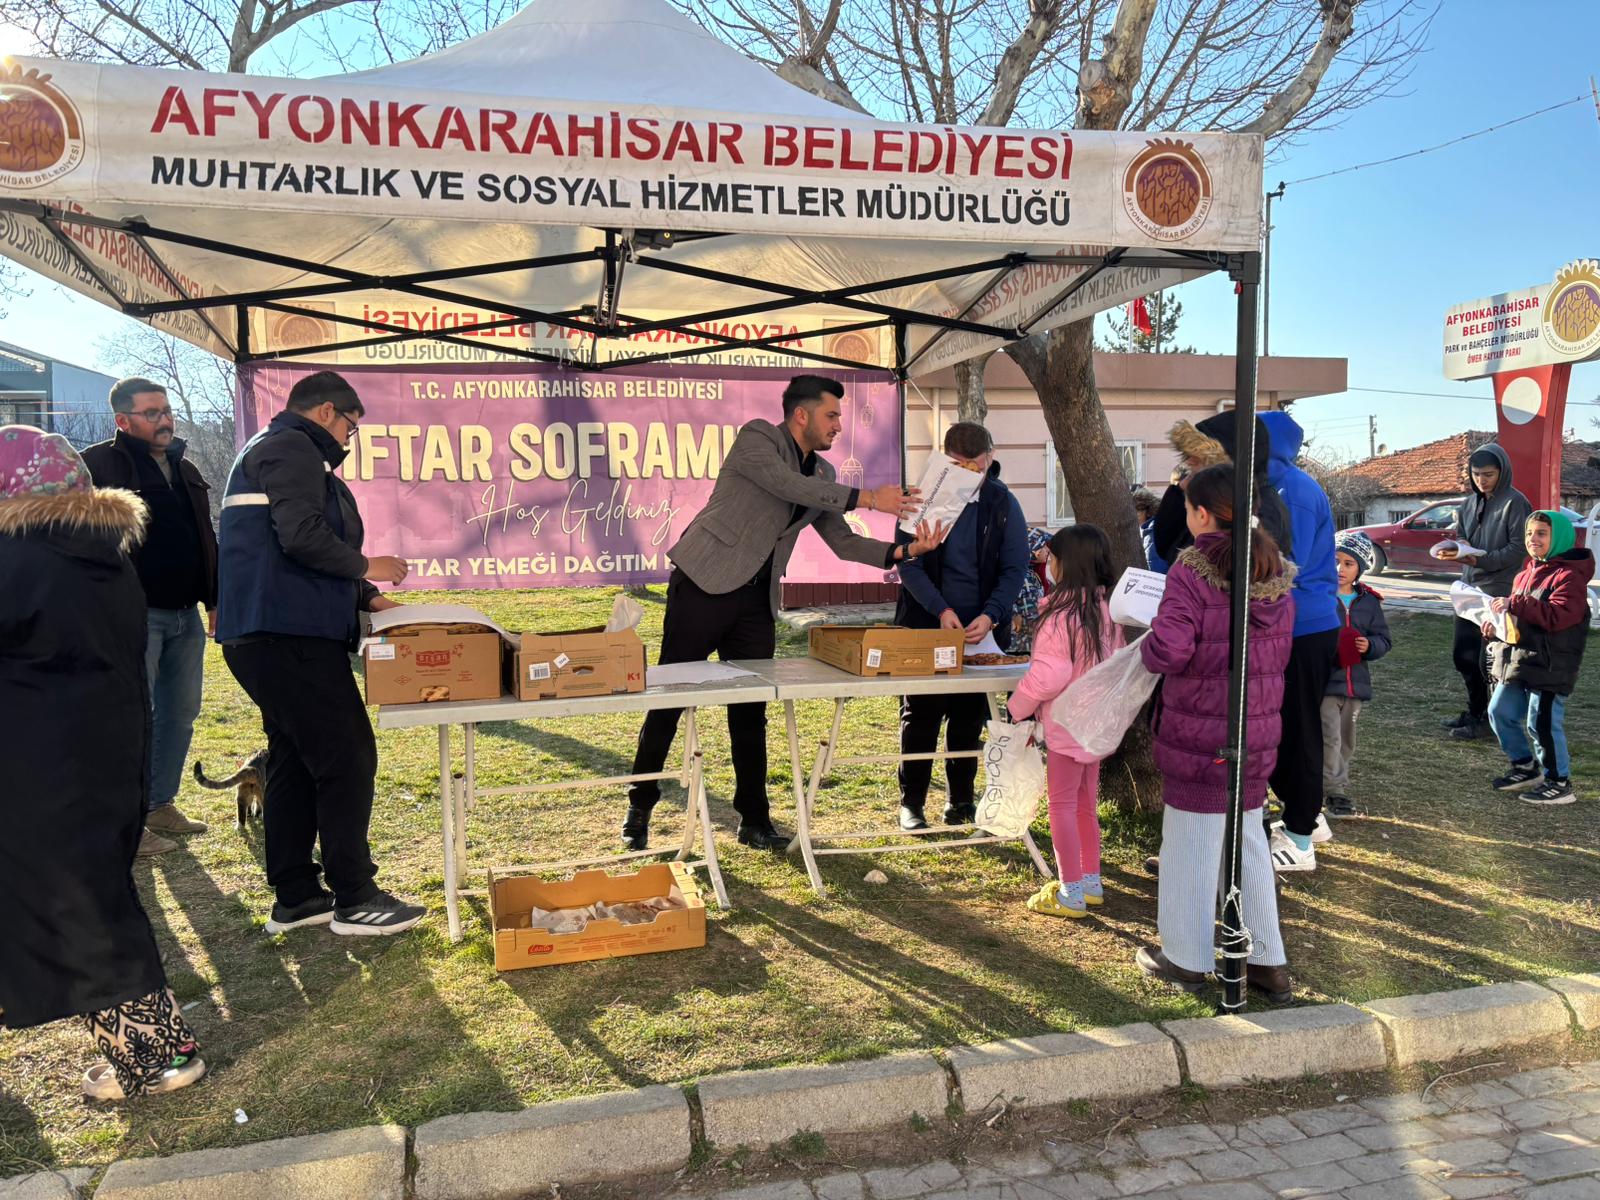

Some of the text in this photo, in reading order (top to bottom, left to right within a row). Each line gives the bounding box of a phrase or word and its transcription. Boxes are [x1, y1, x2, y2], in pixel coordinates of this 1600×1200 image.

[151, 85, 1073, 181] AFYONKARAHİSAR BELEDİYESİ
[152, 156, 1071, 226] MUHTARLIK VE SOSYAL HİZMETLER MÜDÜRLÜĞÜ
[1446, 297, 1539, 326] AFYONKARAHİSAR
[1462, 313, 1521, 337] BELEDİYESİ
[1445, 344, 1459, 354] PARK
[410, 377, 724, 400] T.C. AFYONKARAHİSAR BELEDİYESİ
[509, 421, 743, 481] SOFRAMI
[466, 478, 681, 546] Hoş Geldiniz
[467, 552, 557, 576] YEMEĞİ
[565, 551, 658, 573] DAĞITIM
